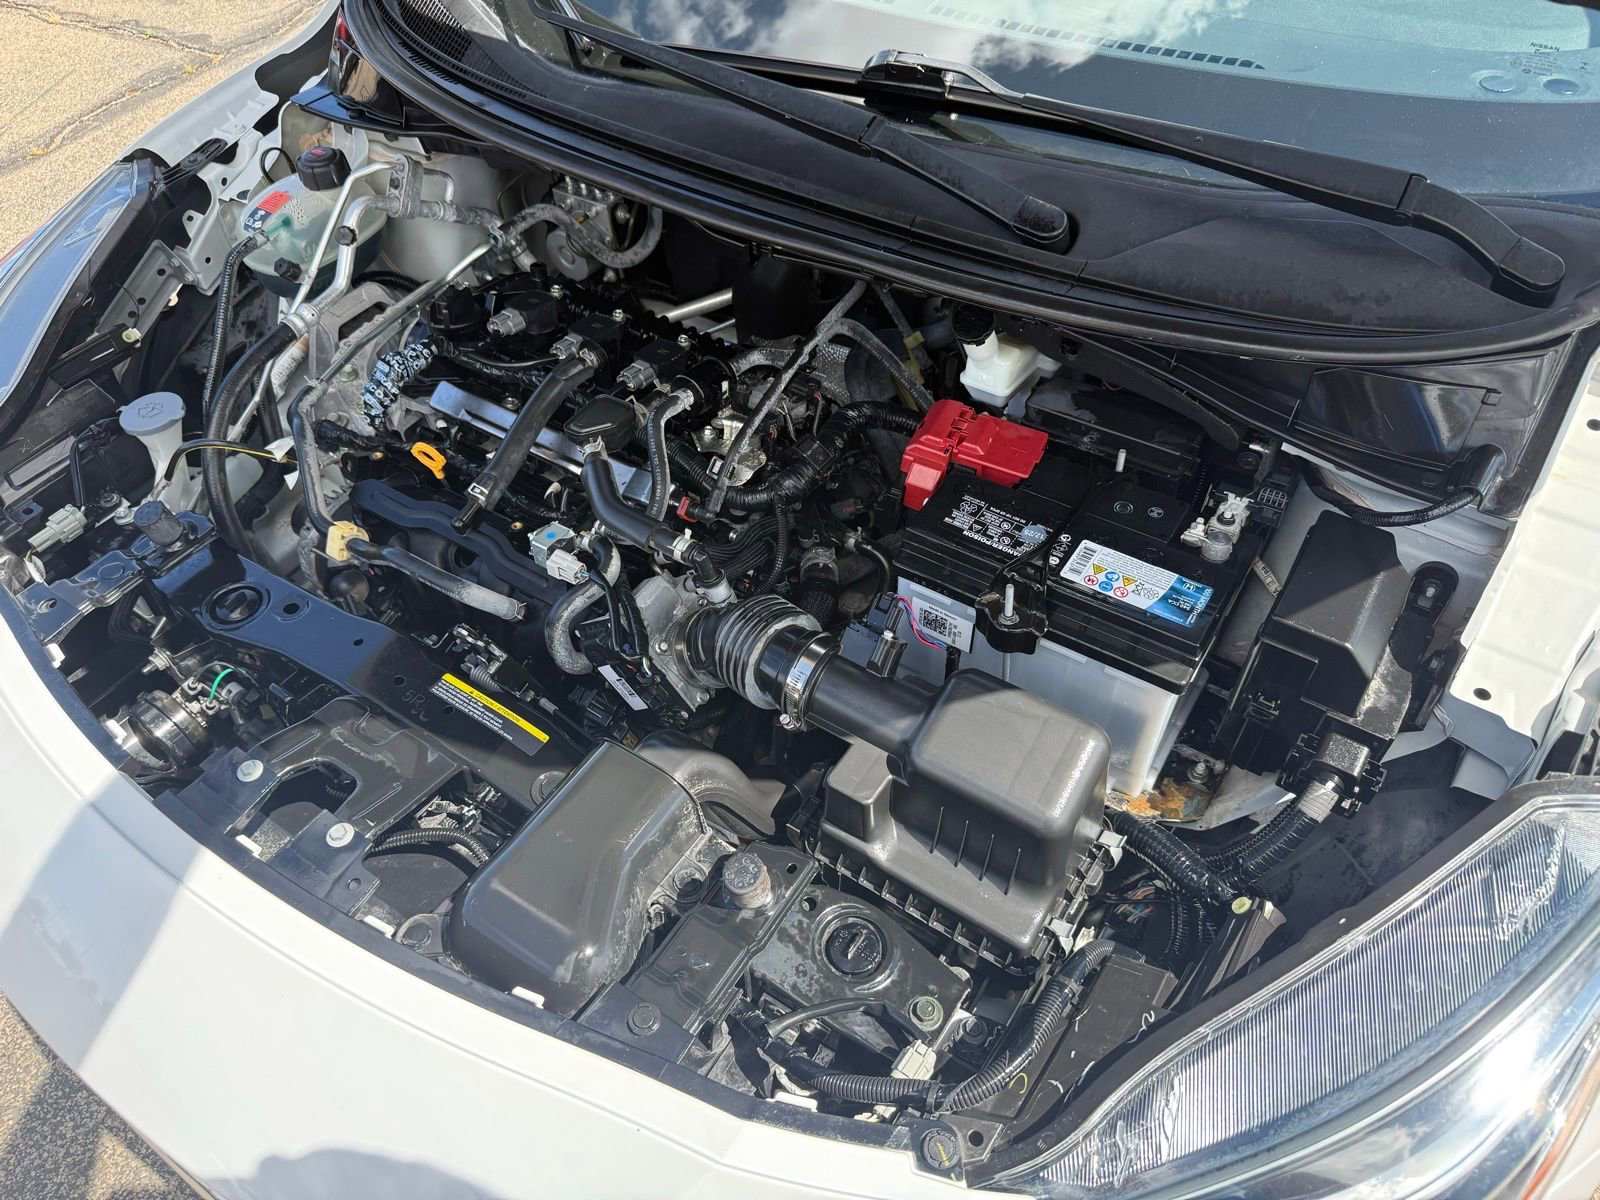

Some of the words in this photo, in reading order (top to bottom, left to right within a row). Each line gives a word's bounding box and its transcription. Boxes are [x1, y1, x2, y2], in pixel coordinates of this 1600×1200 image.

[1529, 42, 1560, 52] NISSAN
[1024, 529, 1044, 540] 12/25
[475, 693, 495, 707] CAUTION
